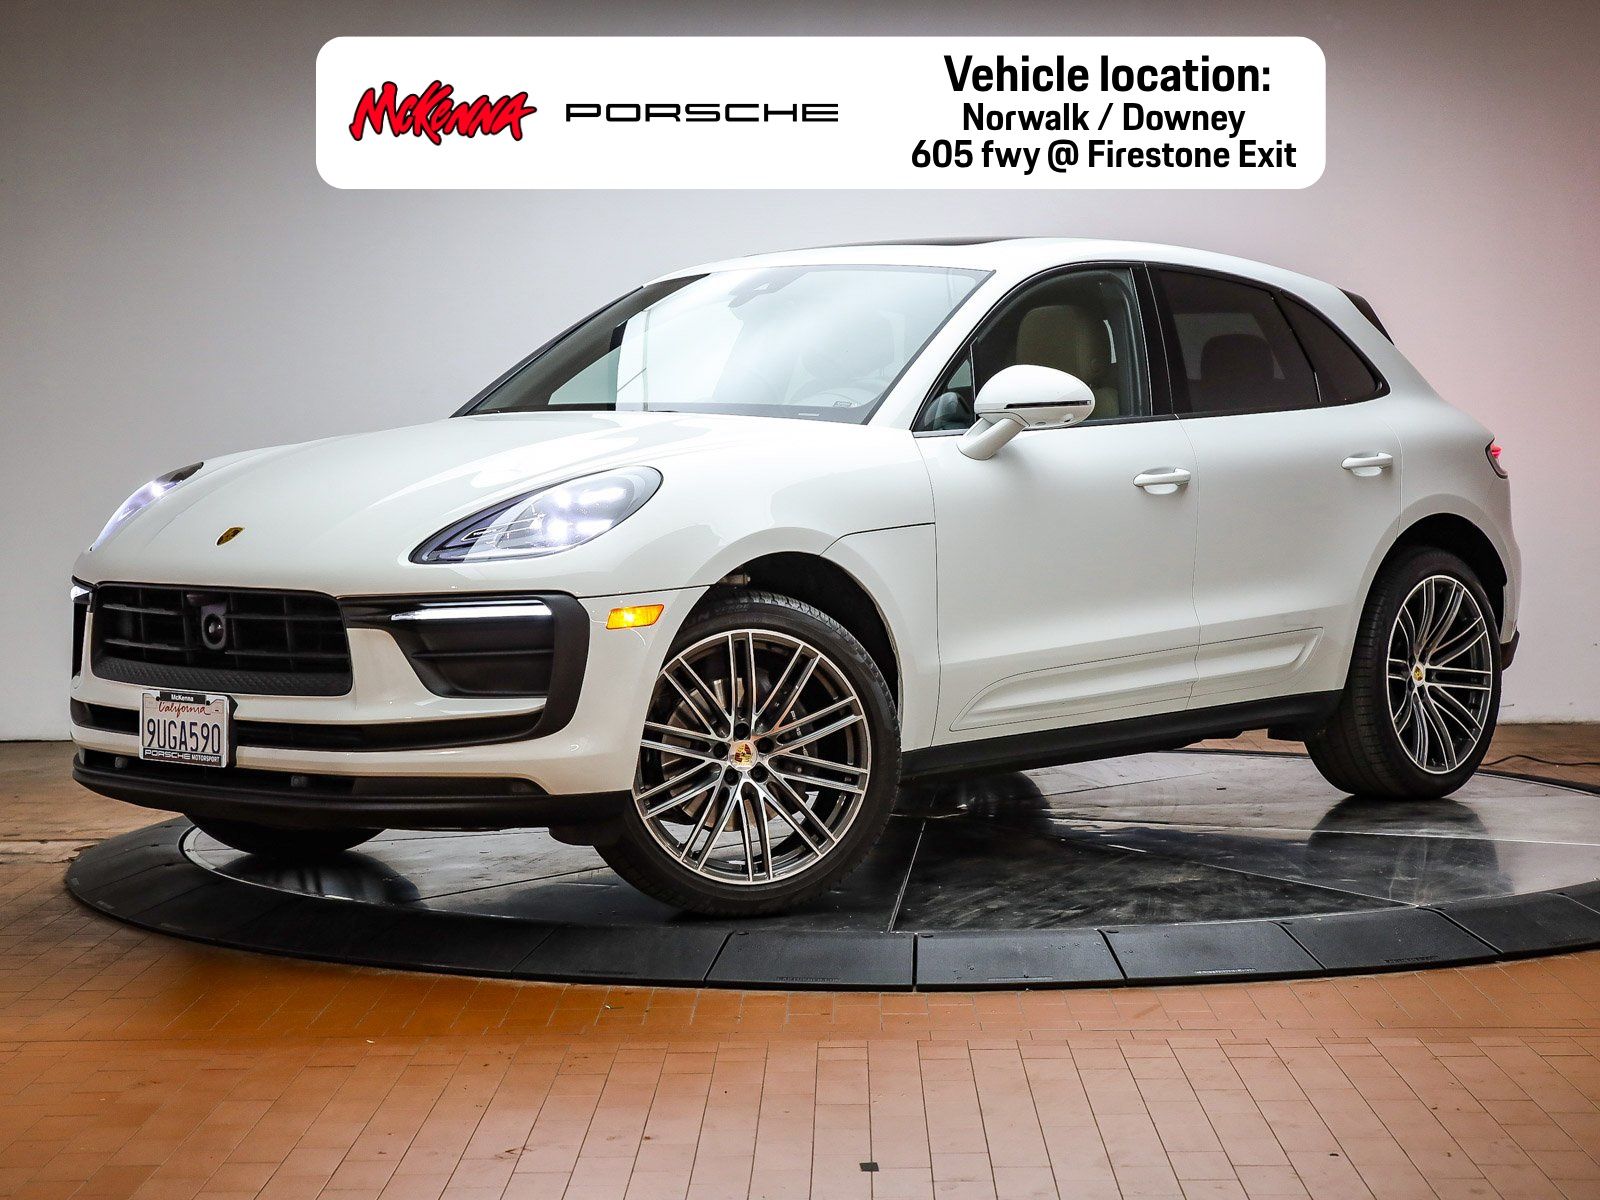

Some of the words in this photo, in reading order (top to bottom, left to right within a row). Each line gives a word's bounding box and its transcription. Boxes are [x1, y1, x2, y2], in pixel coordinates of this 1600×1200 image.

[158, 701, 211, 718] California
[147, 718, 220, 754] 9UGA590
[144, 749, 191, 759] PORSCHE
[191, 754, 220, 763] MOTORSPORT
